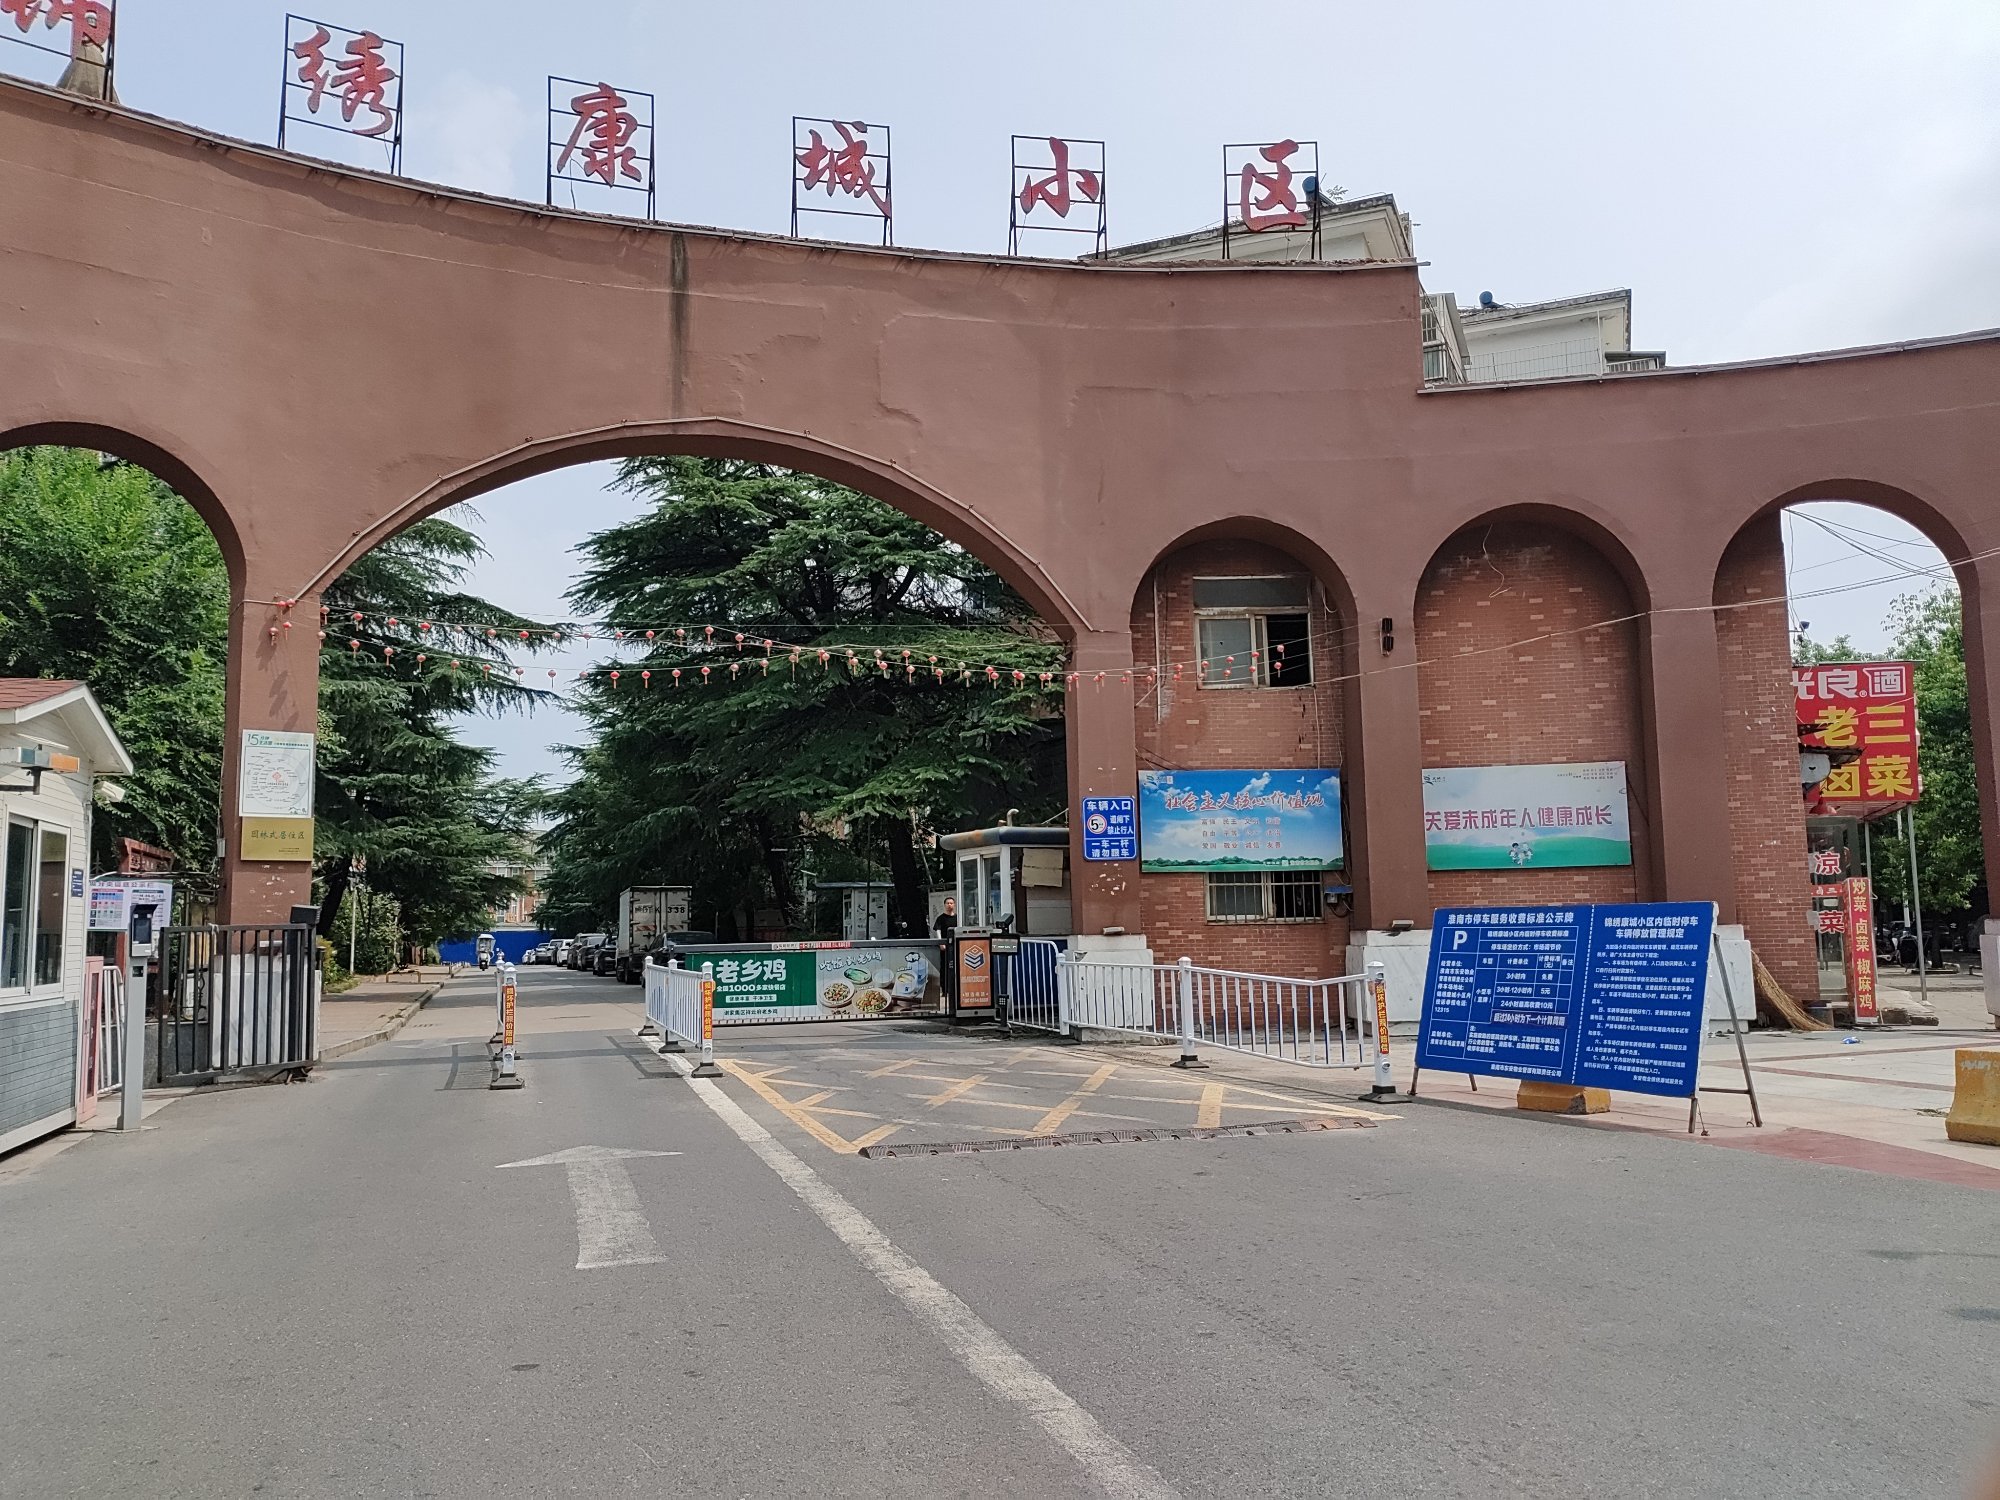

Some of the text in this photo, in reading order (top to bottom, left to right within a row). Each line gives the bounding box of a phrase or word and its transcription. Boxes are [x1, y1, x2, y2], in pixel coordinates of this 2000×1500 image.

[1814, 705, 1910, 746] 老三
[1086, 800, 1131, 811] 车辆入口
[1165, 789, 1325, 812] 社会主义核心价值观
[1425, 804, 1613, 832] 关爱未成年人健康成长
[1091, 818, 1099, 831] 5
[1107, 826, 1134, 835] 禁止行人
[1091, 839, 1130, 848] 一车一杆
[1091, 848, 1130, 858] 请勿跟车
[1448, 911, 1575, 925] 淮南市停车服务收费标准公示牌
[1604, 916, 1699, 928] 锦绣康城小区内临时停车
[1615, 928, 1685, 939] 车辆停放管理规定
[1452, 930, 1468, 950] P
[1852, 879, 1873, 1010] 炒菜 卤菜 椒麻鸡
[716, 958, 787, 983] 老乡鸡
[1505, 972, 1526, 981] 3小时内
[716, 983, 786, 992] 全国1000多家快餐店
[1540, 987, 1551, 995] 5元
